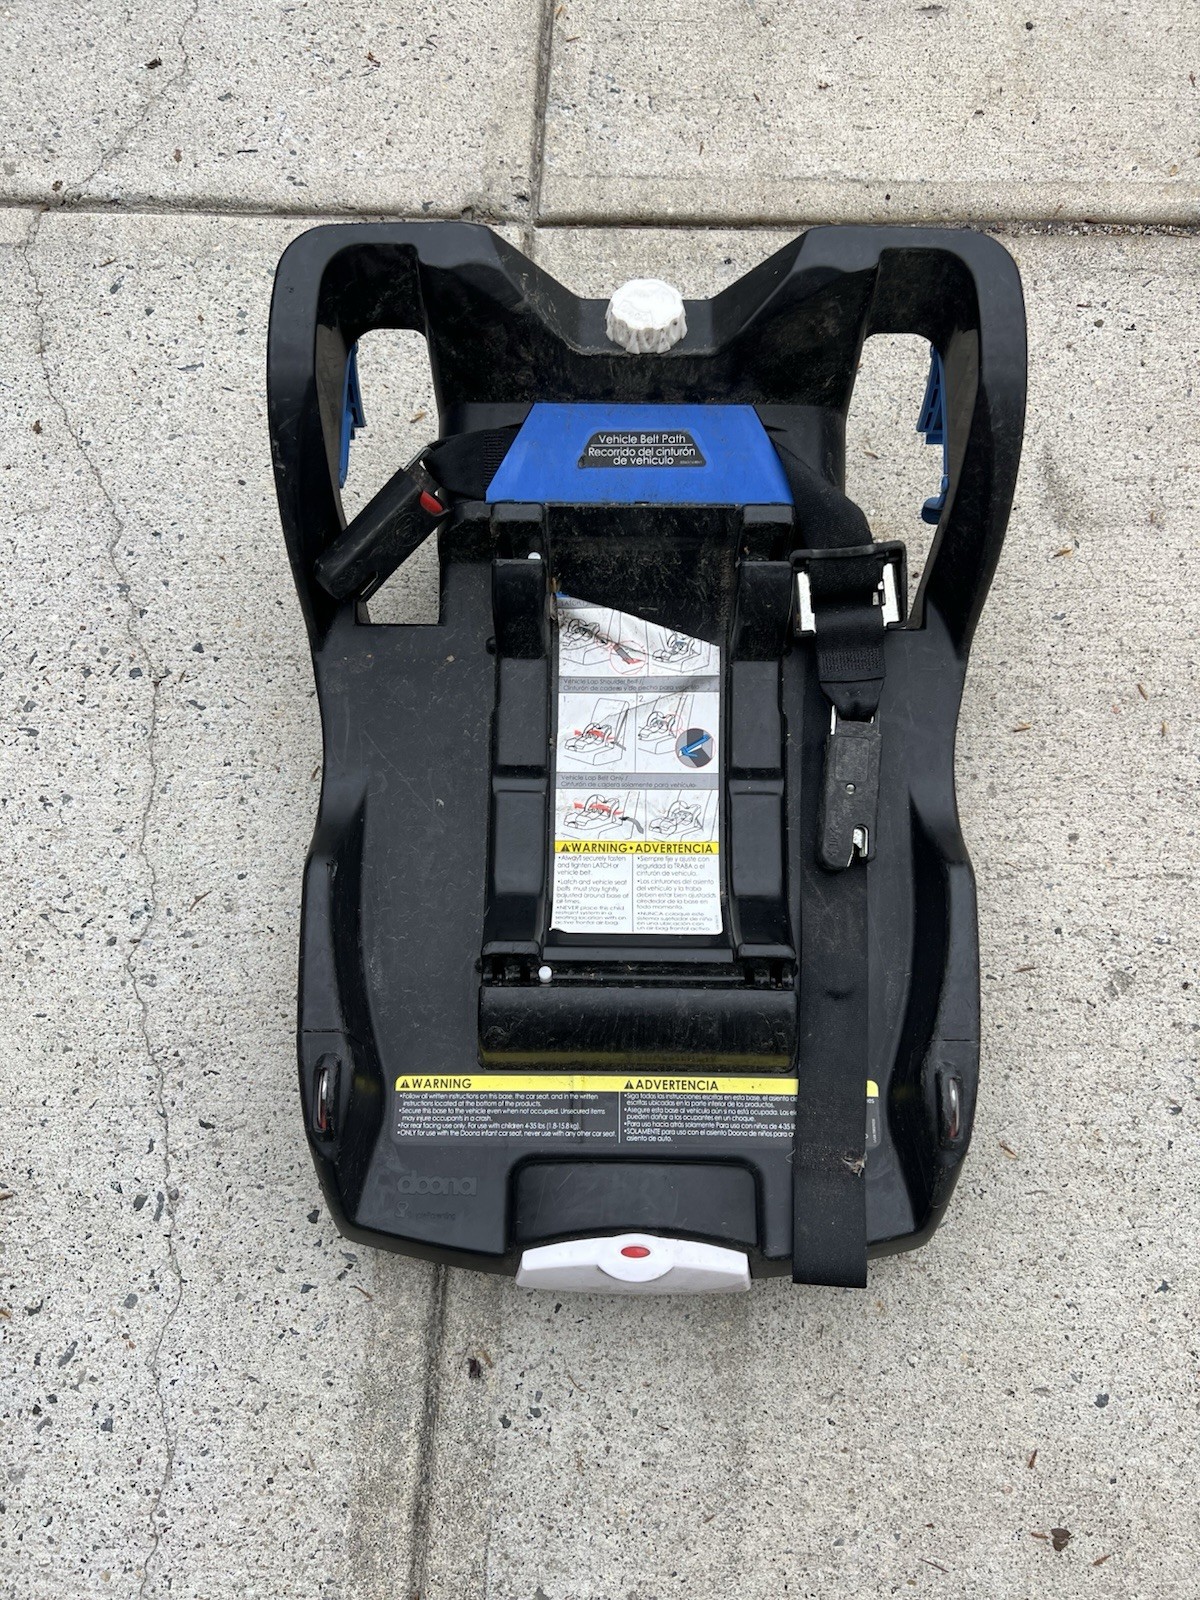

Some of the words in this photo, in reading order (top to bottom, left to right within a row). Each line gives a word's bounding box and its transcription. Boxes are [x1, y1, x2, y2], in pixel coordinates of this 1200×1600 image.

[598, 434, 638, 444] Vehicle
[640, 434, 659, 444] Belt
[662, 434, 686, 444] Path
[588, 447, 636, 456] Recorrido
[638, 447, 654, 456] del
[656, 447, 695, 456] cinturón
[613, 456, 628, 465] de
[571, 843, 628, 853] WARNING
[635, 844, 713, 853] ADVERTENCIA
[411, 1079, 472, 1089] WARNING
[635, 1079, 719, 1090] ADVERTENCIA
[397, 1170, 478, 1195] doona
